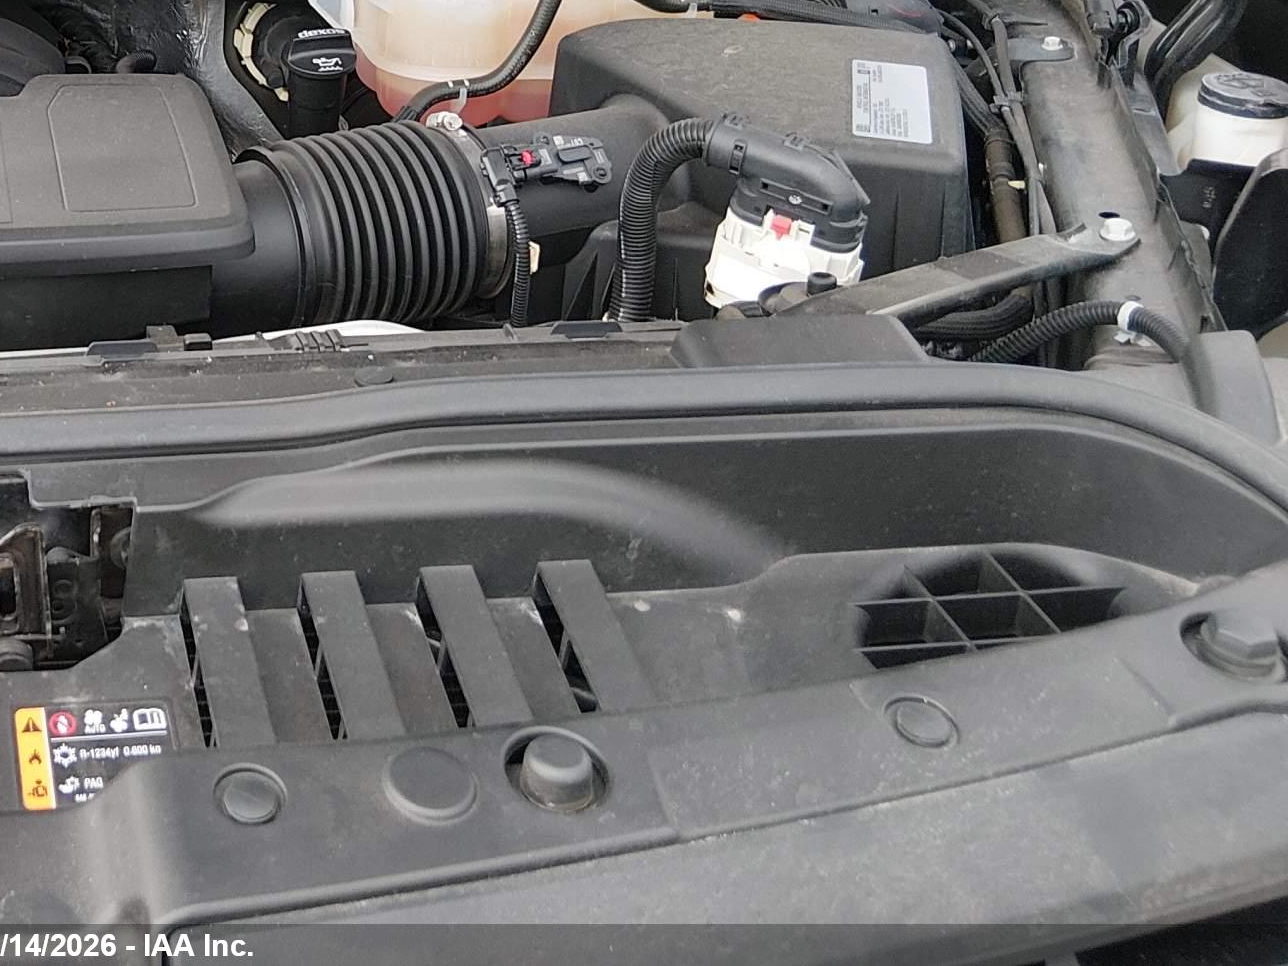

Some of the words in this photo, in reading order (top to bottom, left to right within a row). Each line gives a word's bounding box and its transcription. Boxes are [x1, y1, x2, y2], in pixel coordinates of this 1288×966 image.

[297, 28, 345, 38] dexos
[84, 723, 106, 734] AUTO
[84, 777, 104, 789] PAG
